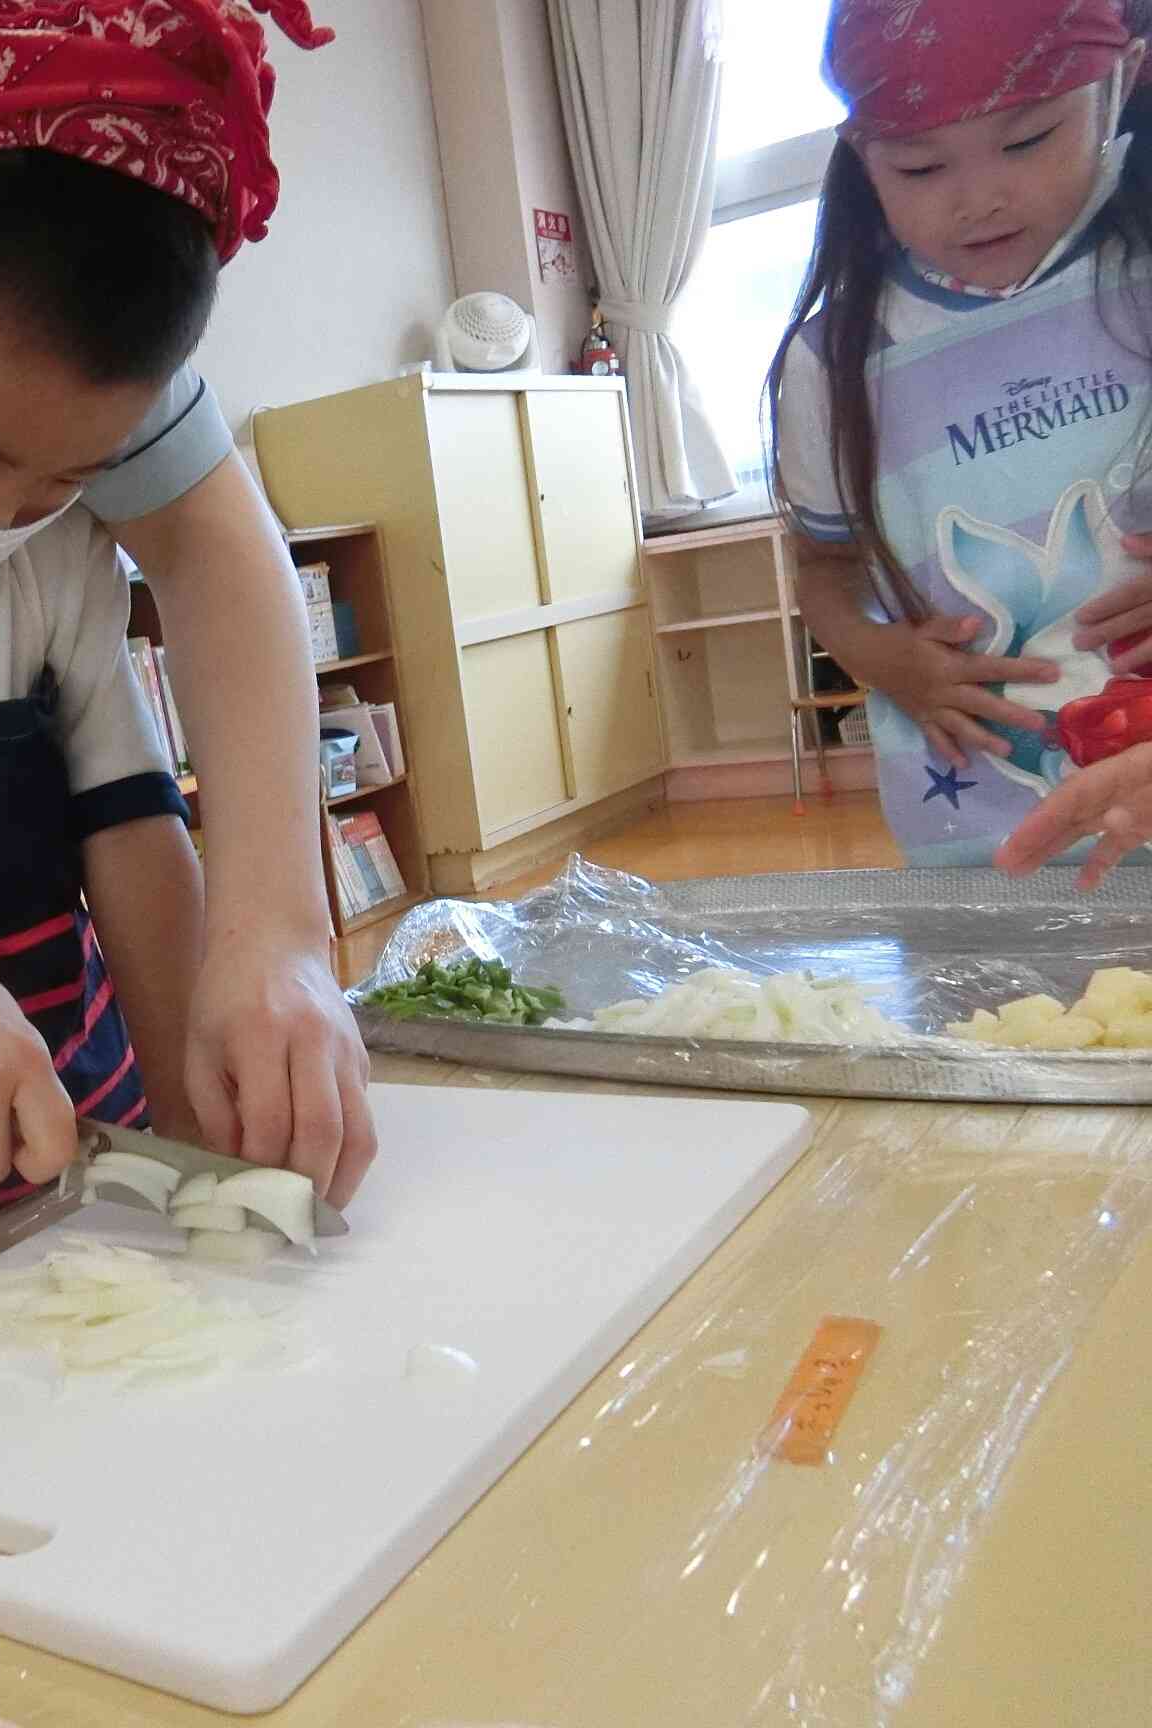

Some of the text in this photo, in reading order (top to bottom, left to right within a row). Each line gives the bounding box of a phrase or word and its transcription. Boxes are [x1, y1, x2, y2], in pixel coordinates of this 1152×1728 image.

[993, 369, 1117, 418] THE LITTLE
[1002, 376, 1052, 396] Disney
[945, 383, 1129, 465] MERMAID
